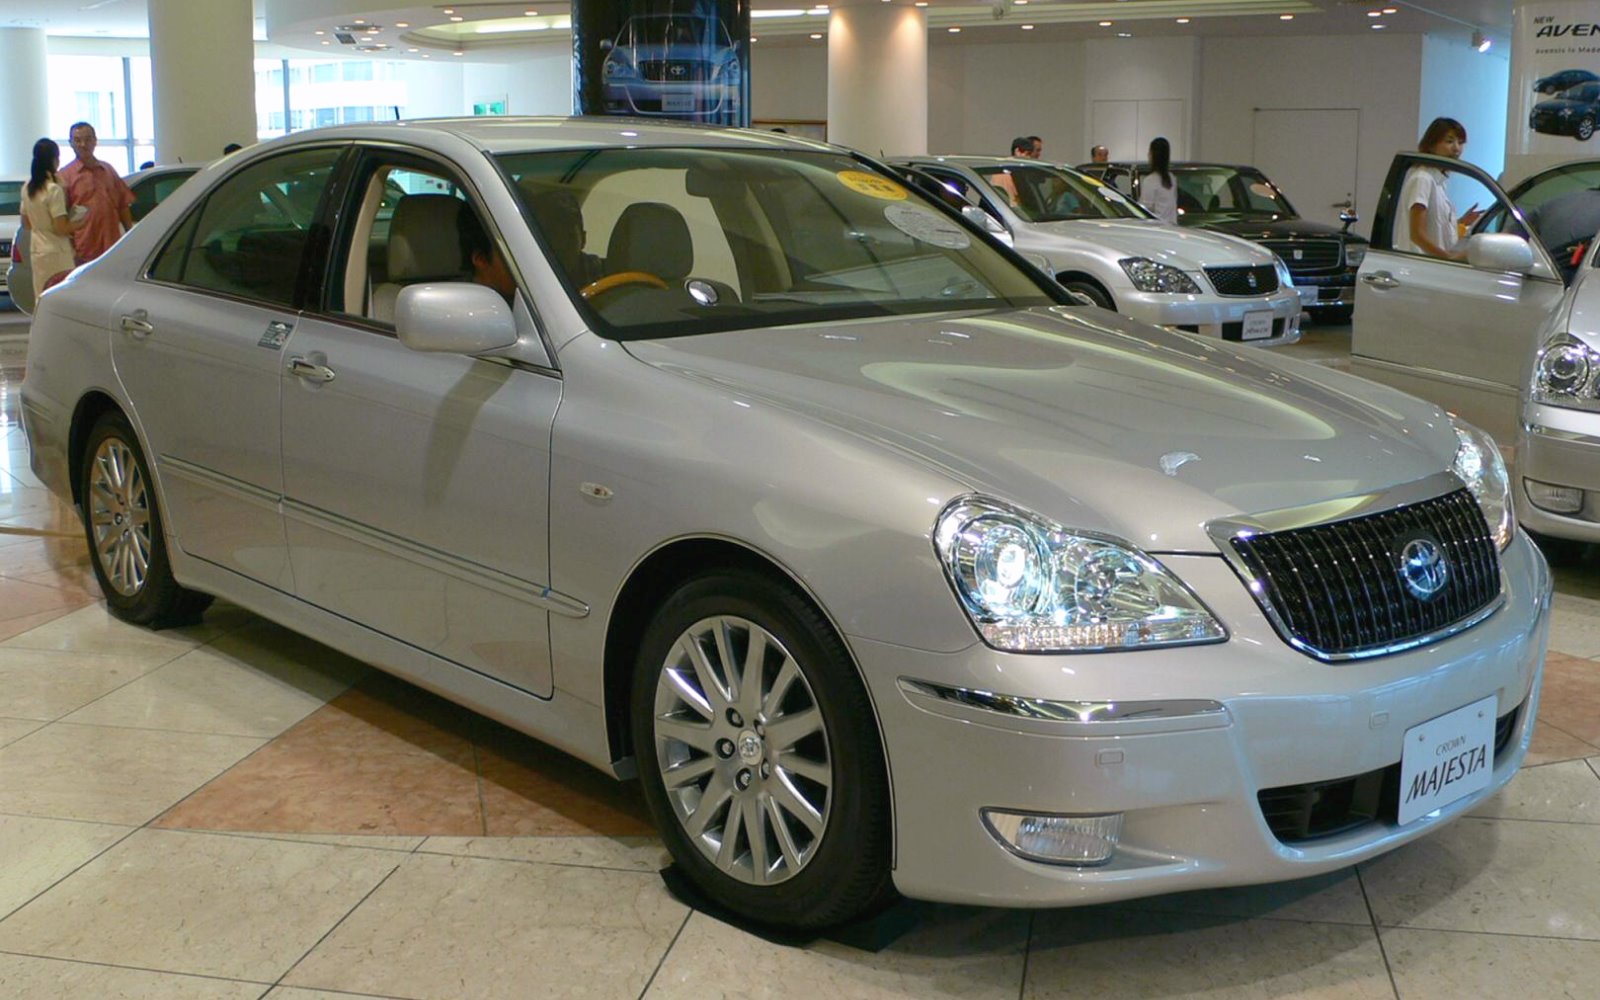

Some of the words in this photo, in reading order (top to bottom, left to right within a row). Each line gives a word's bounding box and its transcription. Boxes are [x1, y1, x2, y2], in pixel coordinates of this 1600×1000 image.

[1533, 16, 1555, 24] NEW
[1435, 734, 1467, 756] CROWN
[1405, 743, 1487, 804] MAJESTA
